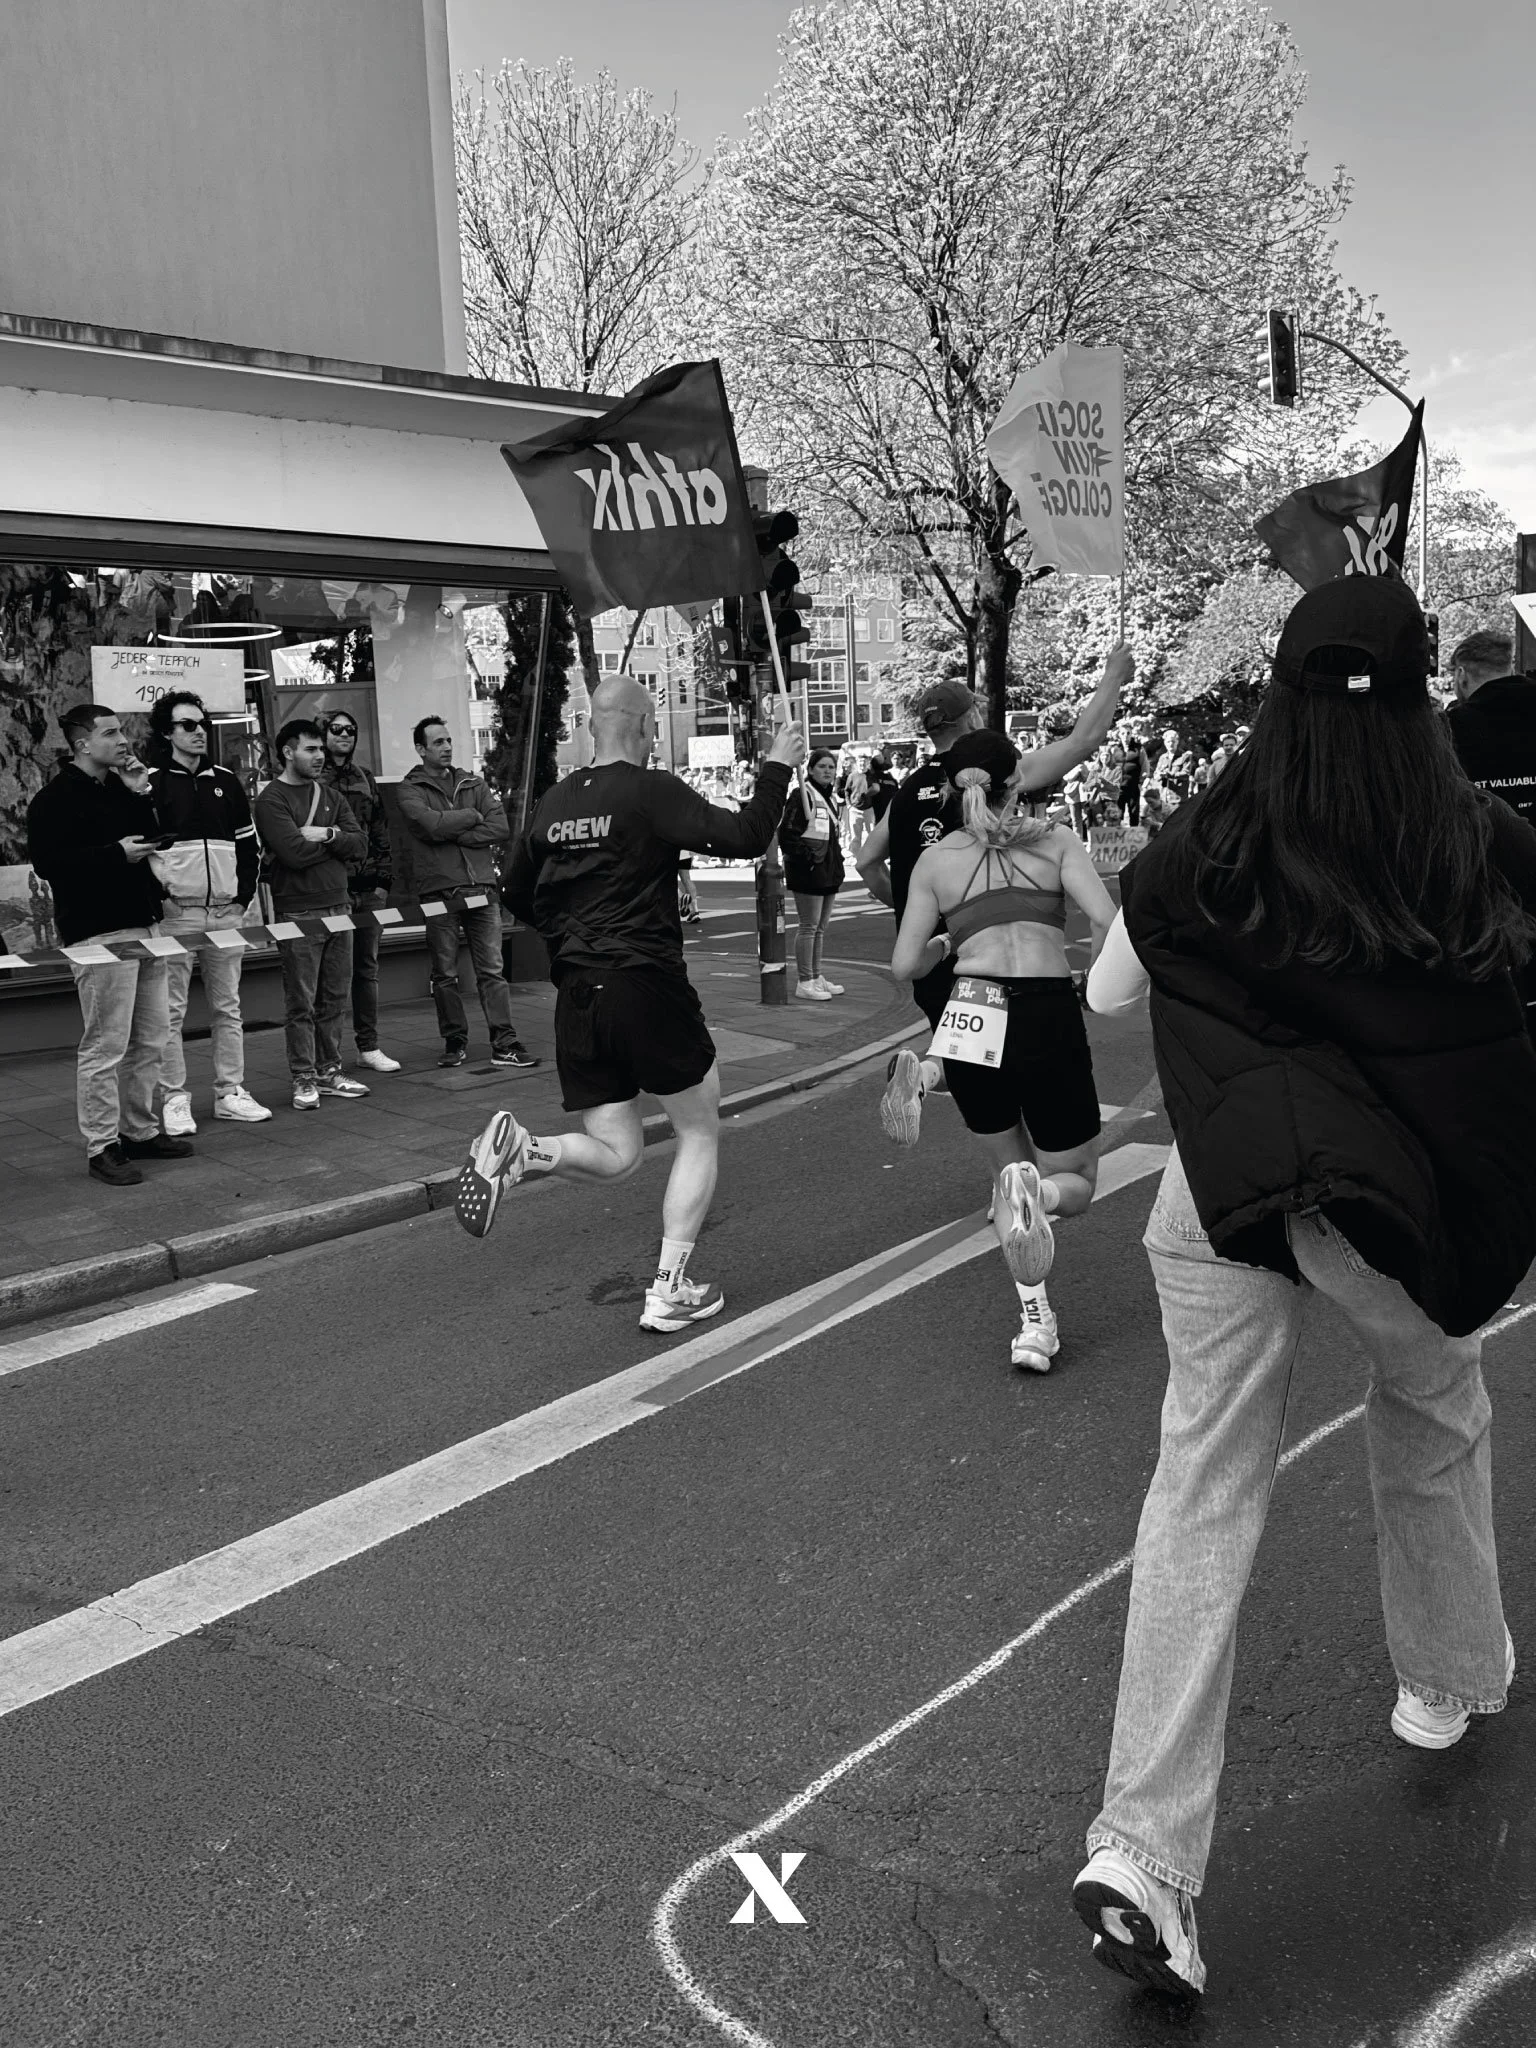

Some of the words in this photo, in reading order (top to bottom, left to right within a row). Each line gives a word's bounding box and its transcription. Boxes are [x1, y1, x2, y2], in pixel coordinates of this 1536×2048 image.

[111, 652, 148, 669] JEDER
[157, 654, 200, 668] TEPPICH
[1490, 776, 1536, 788] VALUABL
[547, 814, 612, 843] CREW
[958, 980, 973, 990] uni
[985, 986, 1001, 997] uni
[958, 989, 976, 999] per
[986, 994, 1005, 1004] per
[941, 1011, 984, 1032] 2150
